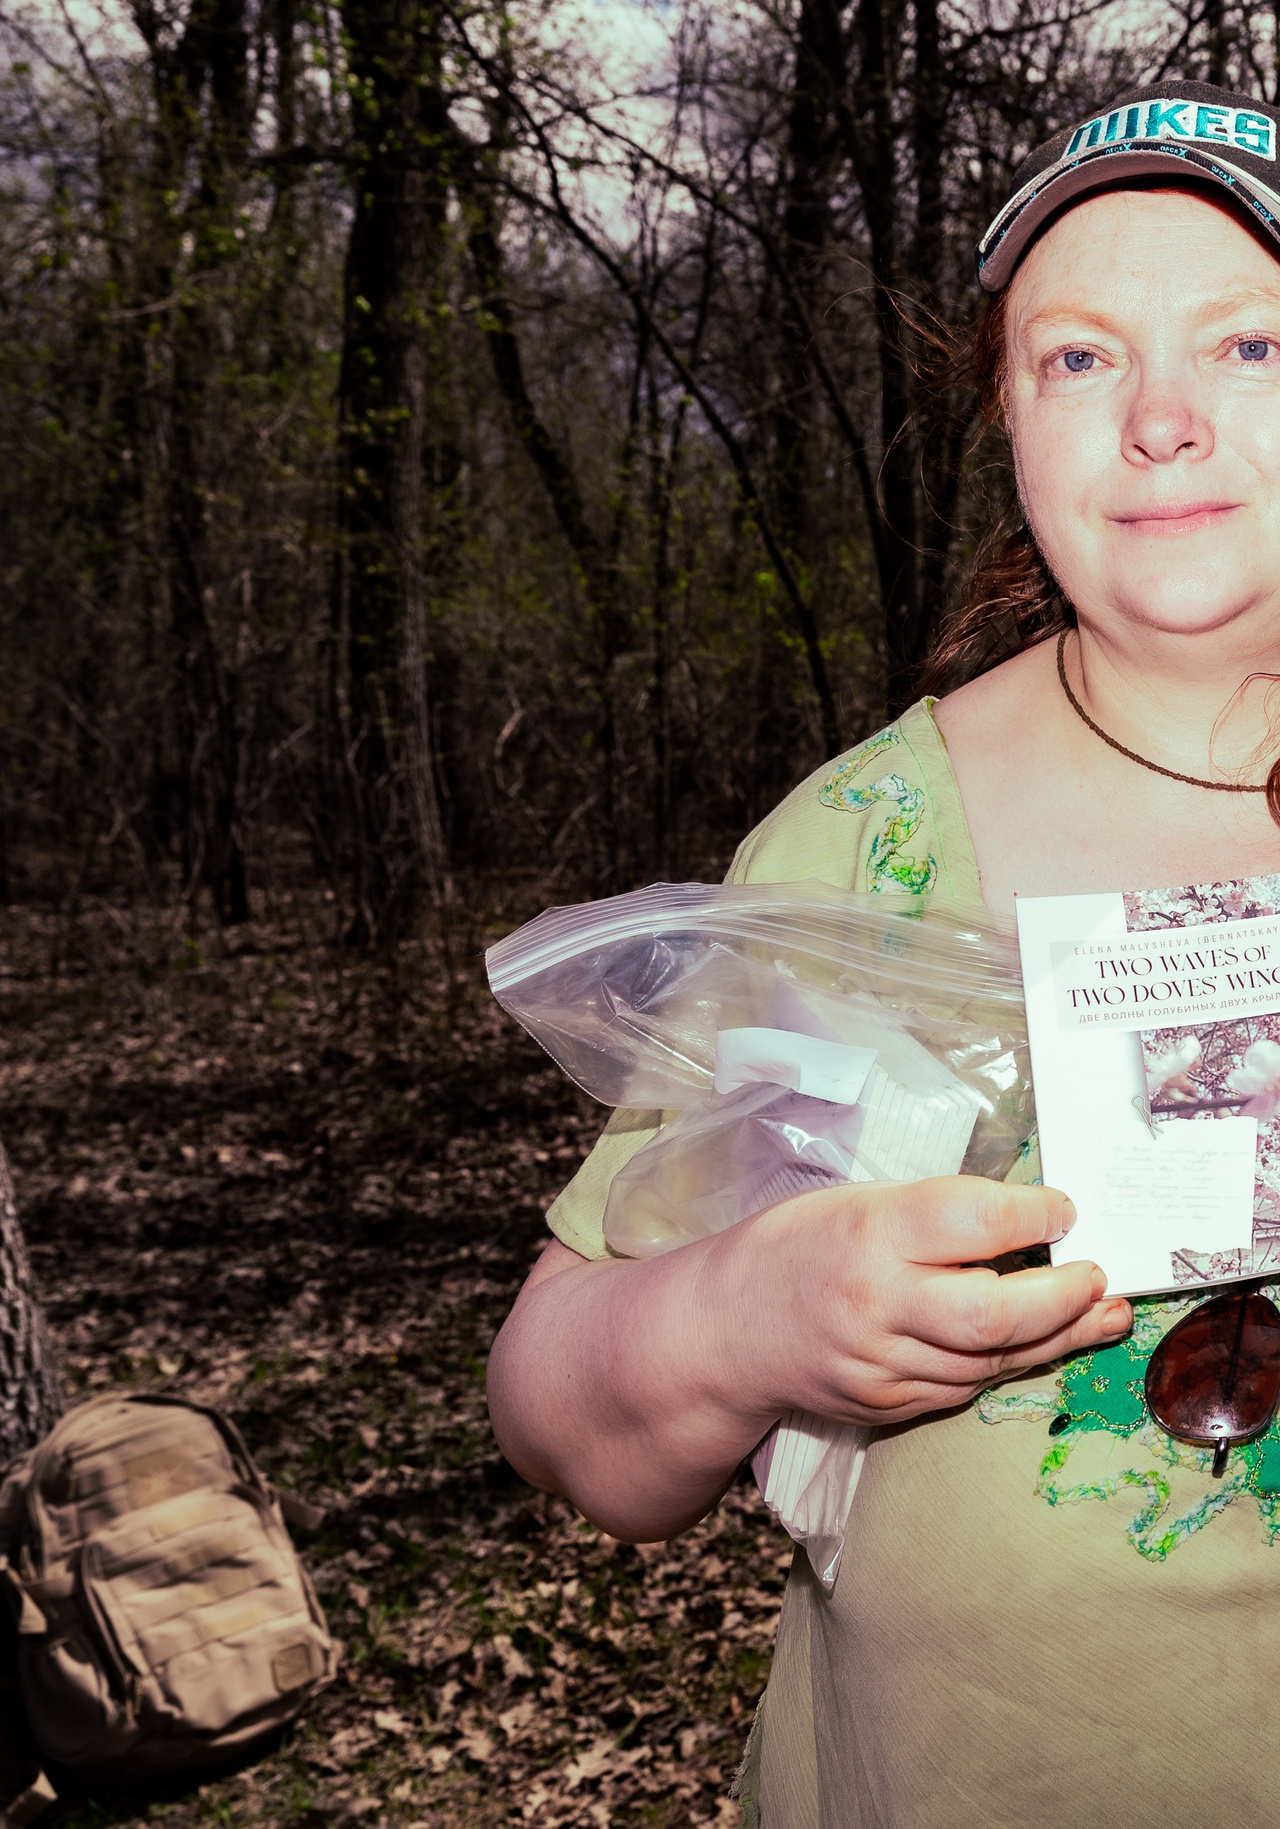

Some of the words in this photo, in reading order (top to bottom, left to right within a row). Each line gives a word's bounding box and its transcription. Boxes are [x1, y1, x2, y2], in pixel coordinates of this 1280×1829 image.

[1074, 945, 1113, 956] ELENA
[1120, 938, 1190, 953] MALYSHEVA
[1094, 956, 1153, 979] TWO
[1158, 946, 1239, 973] WAVES
[1243, 944, 1271, 962] OF
[1066, 985, 1126, 1008] TWO
[1132, 975, 1218, 1003] DOVES'
[1079, 1013, 1100, 1024] ДВЕ
[1104, 1010, 1145, 1021] ВОЛНЫ
[1148, 1001, 1217, 1017] ГОЛУБИНЫХ
[1220, 997, 1248, 1010] ДВУХ
